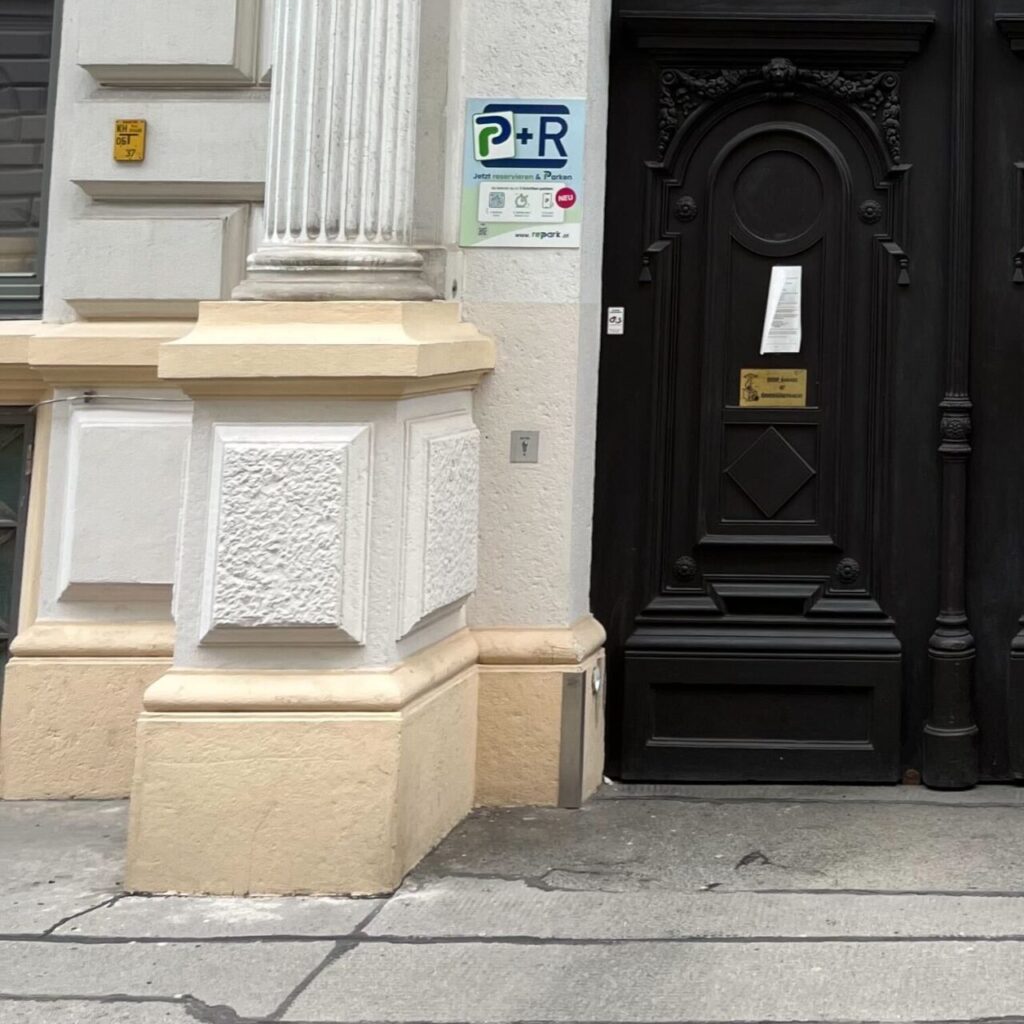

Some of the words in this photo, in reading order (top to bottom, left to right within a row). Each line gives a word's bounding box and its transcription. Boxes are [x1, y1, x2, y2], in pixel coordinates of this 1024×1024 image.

[492, 173, 534, 181] reservieren
[543, 170, 573, 181] Parken
[557, 194, 574, 202] NEU
